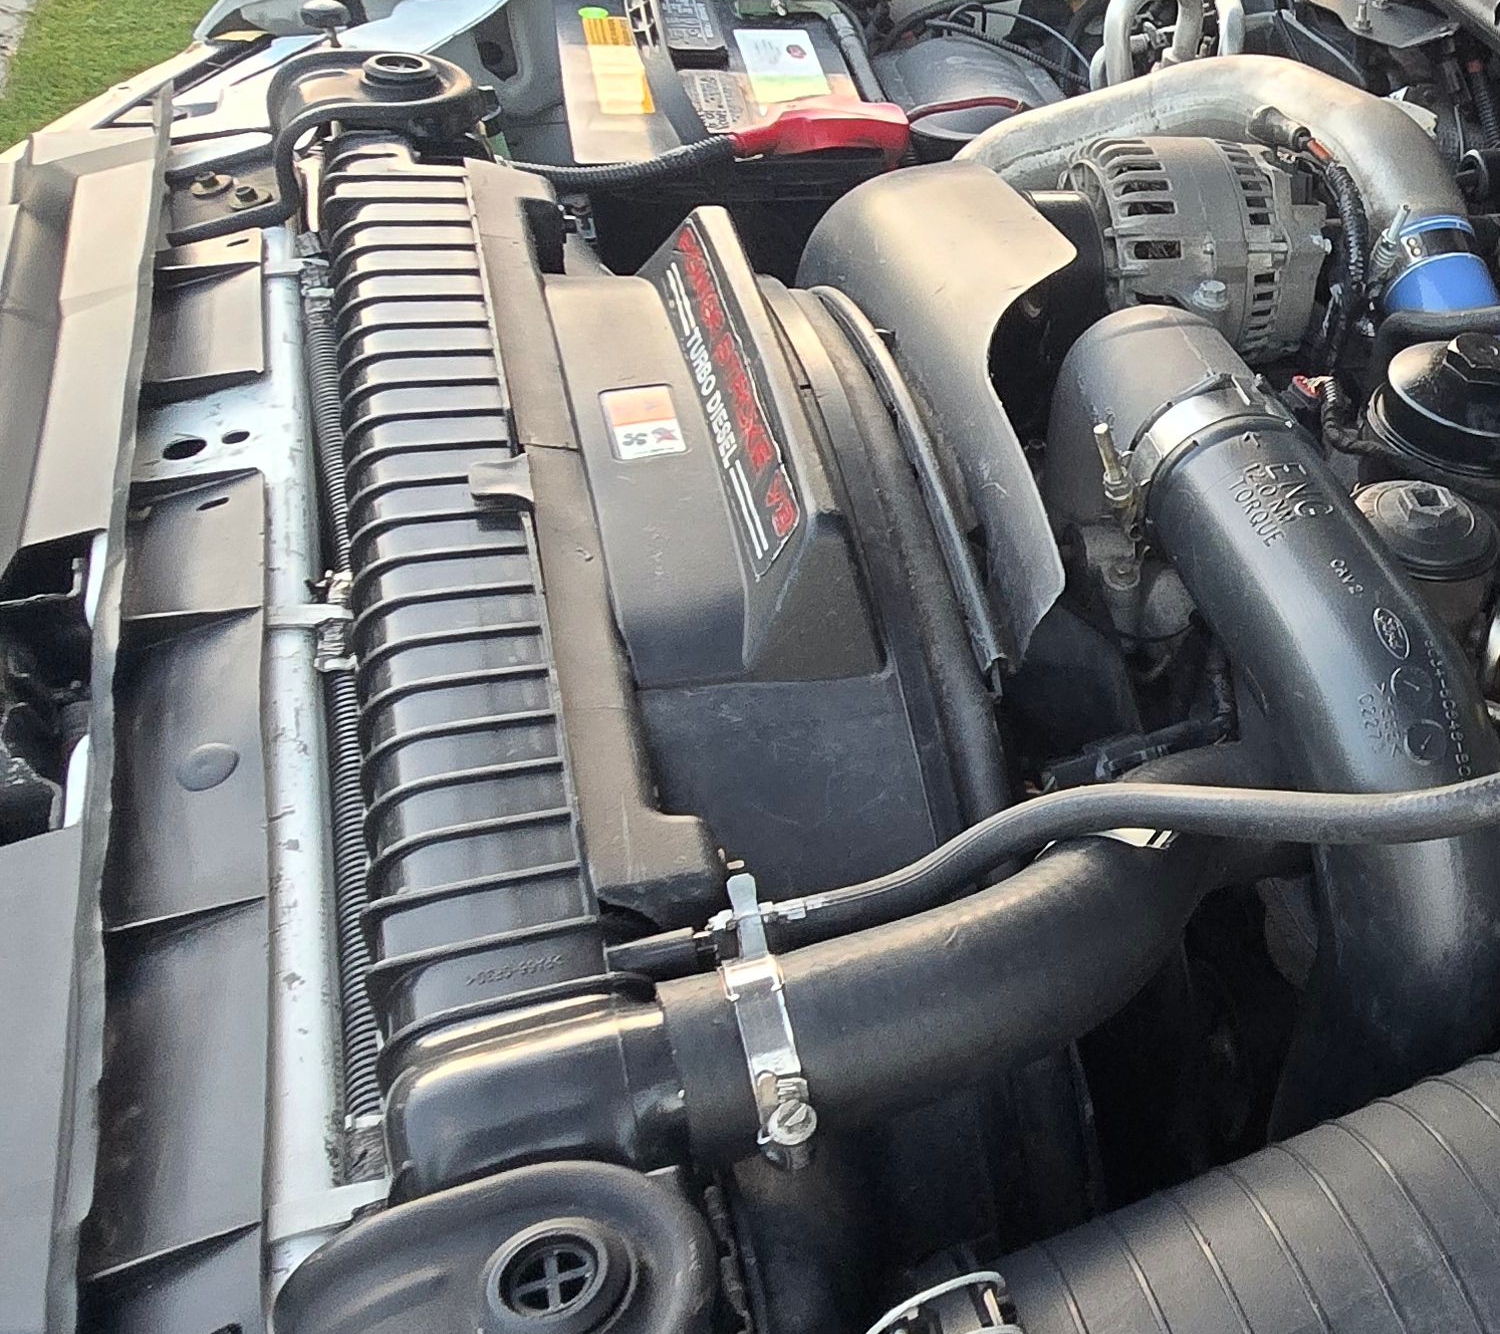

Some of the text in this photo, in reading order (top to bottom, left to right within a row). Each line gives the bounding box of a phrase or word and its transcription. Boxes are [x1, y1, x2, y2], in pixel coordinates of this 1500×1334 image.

[685, 327, 737, 469] TURBO DIESEL
[1227, 476, 1284, 548] TORQUE
[1265, 462, 1333, 517] ENG
